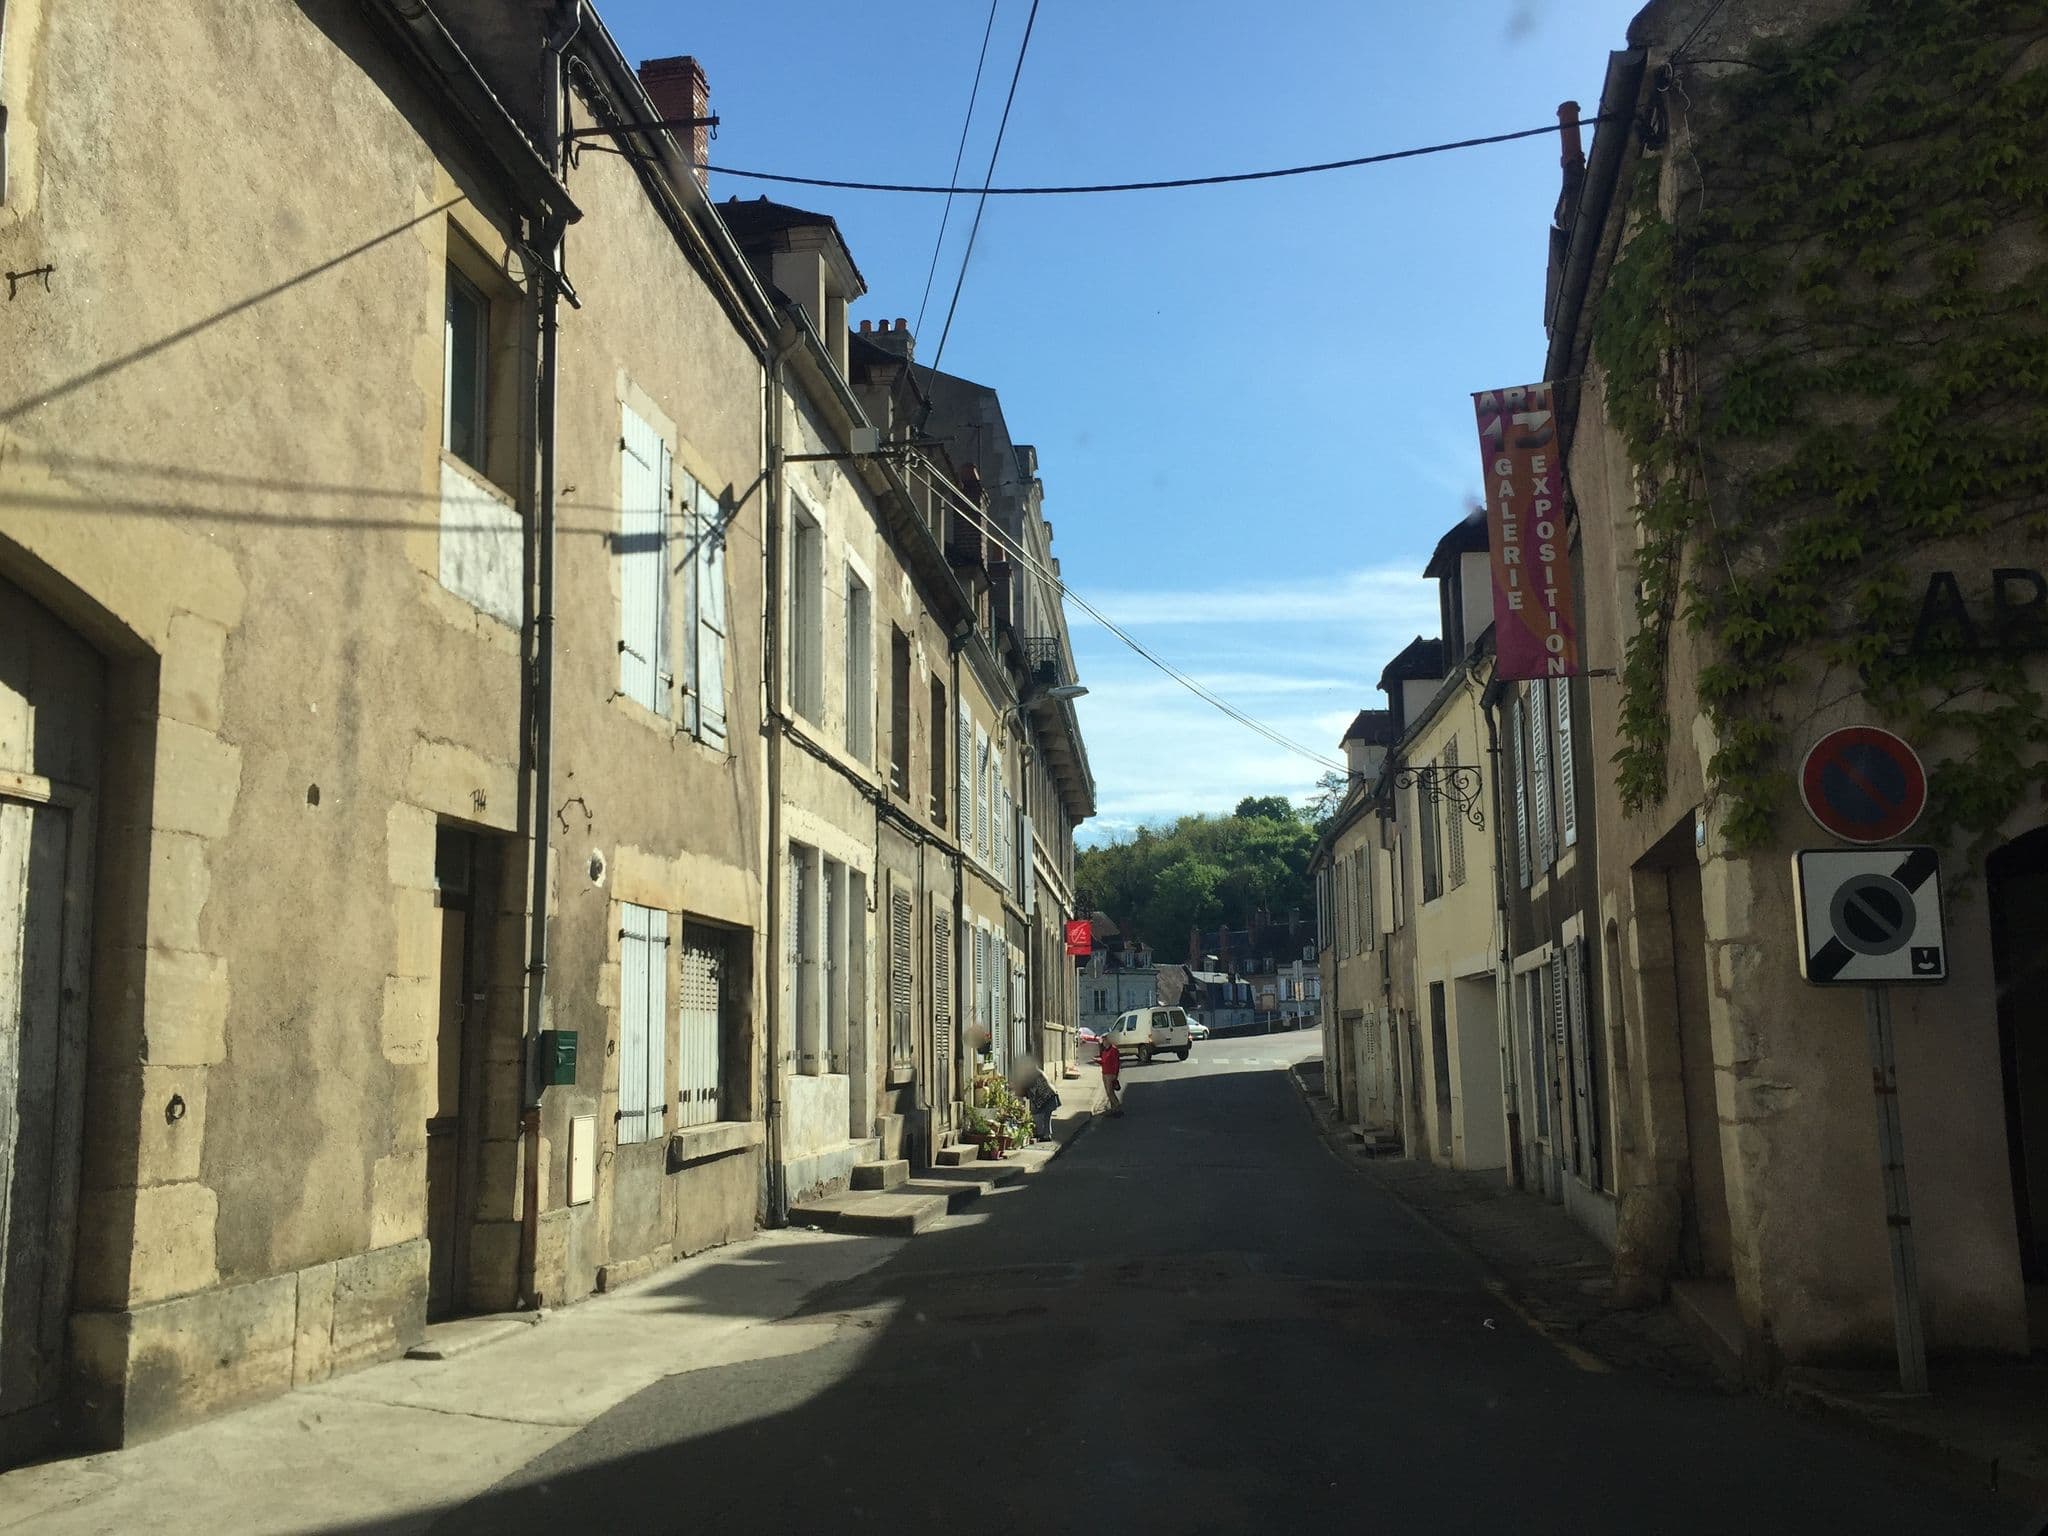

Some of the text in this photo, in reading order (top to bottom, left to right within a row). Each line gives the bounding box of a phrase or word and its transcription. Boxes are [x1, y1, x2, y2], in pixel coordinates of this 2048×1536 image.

[1478, 382, 1552, 417] ART
[1494, 457, 1524, 611] GALERIE
[1530, 454, 1565, 677] EXPOSITION
